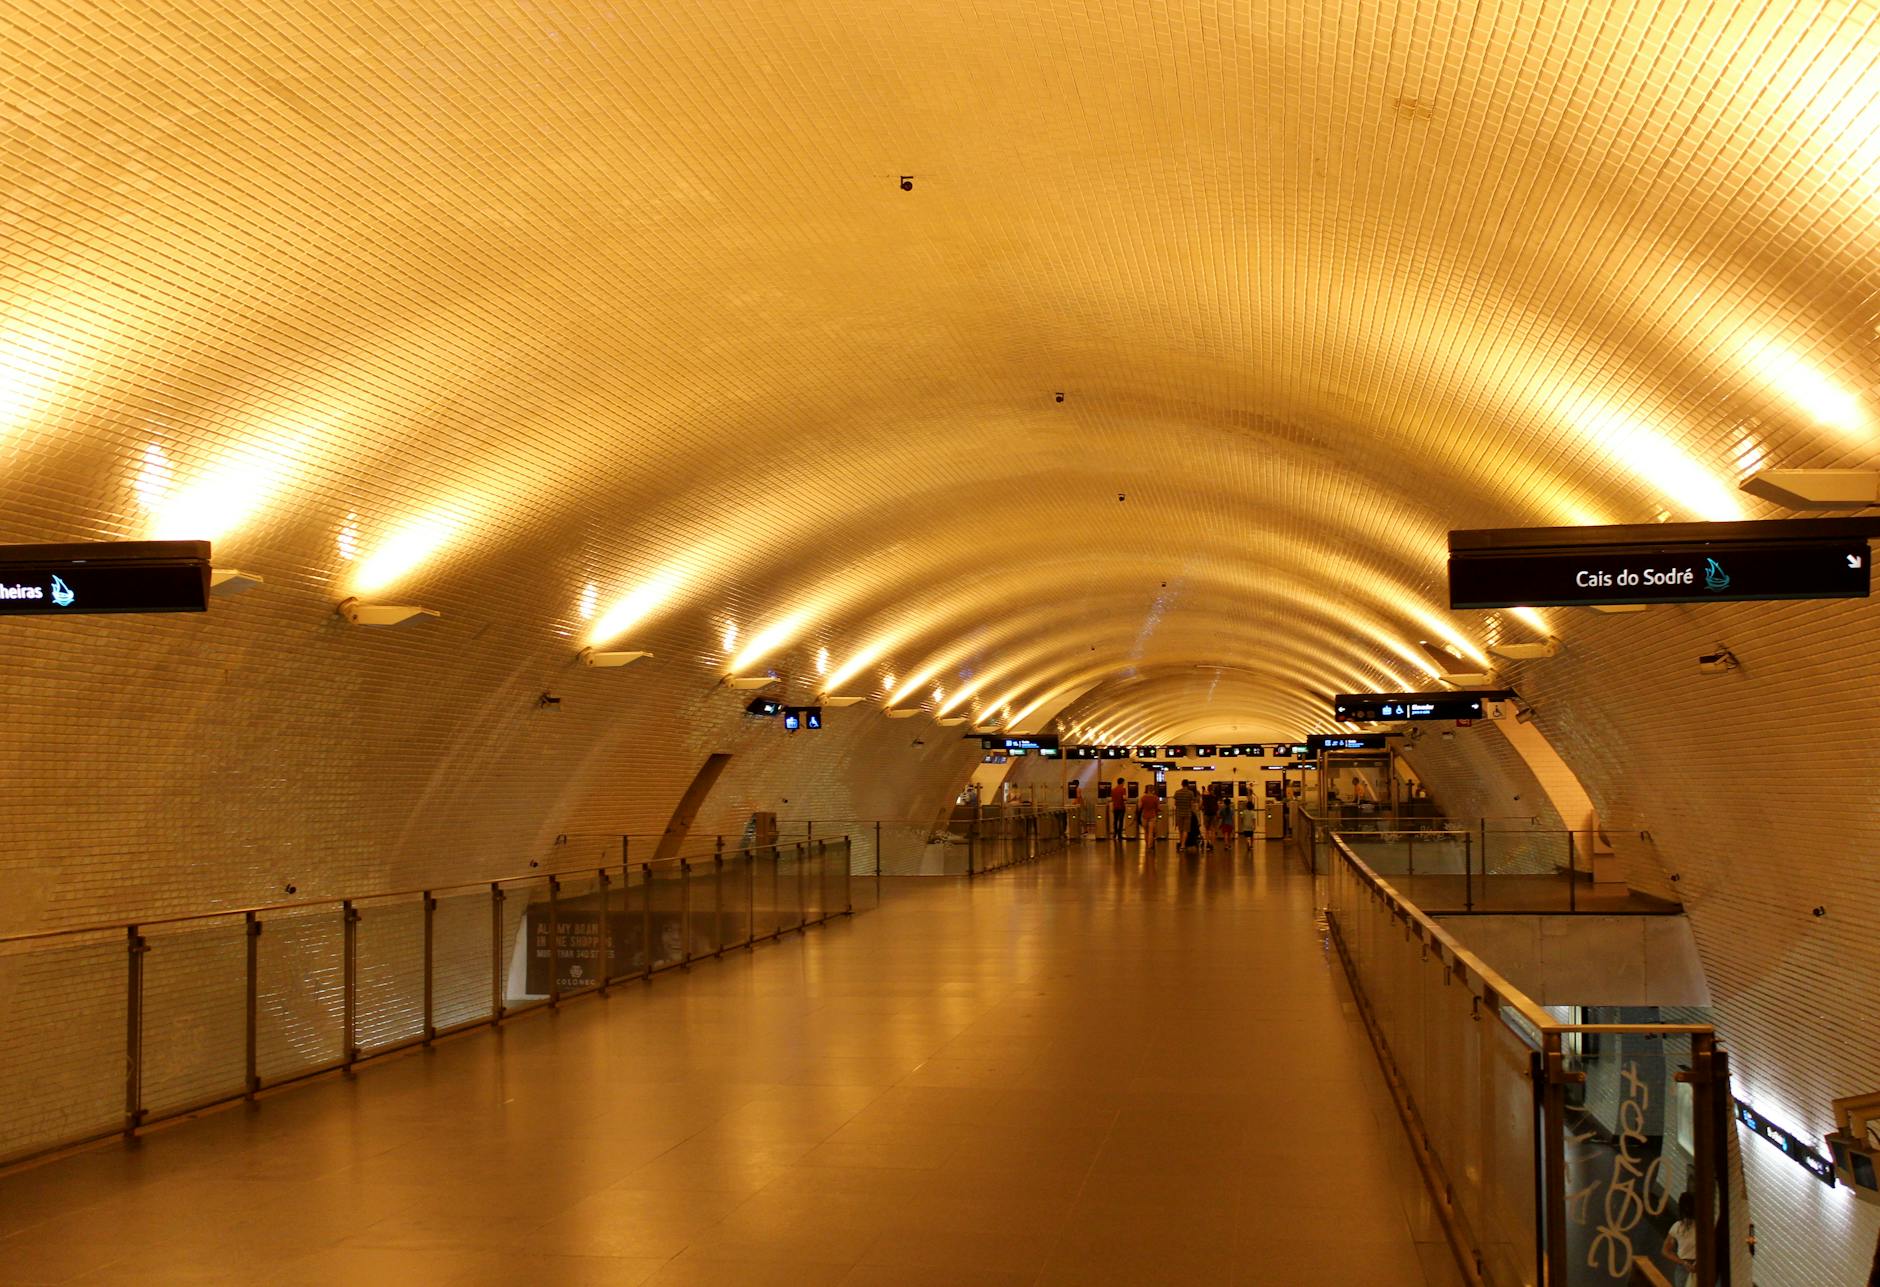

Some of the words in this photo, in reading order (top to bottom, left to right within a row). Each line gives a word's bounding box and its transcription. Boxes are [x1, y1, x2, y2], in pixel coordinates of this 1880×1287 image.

[1576, 570, 1613, 587] Cais
[1616, 569, 1639, 586] do
[1643, 567, 1694, 586] Sodré
[0, 583, 44, 600] heiras
[537, 923, 553, 935] AL
